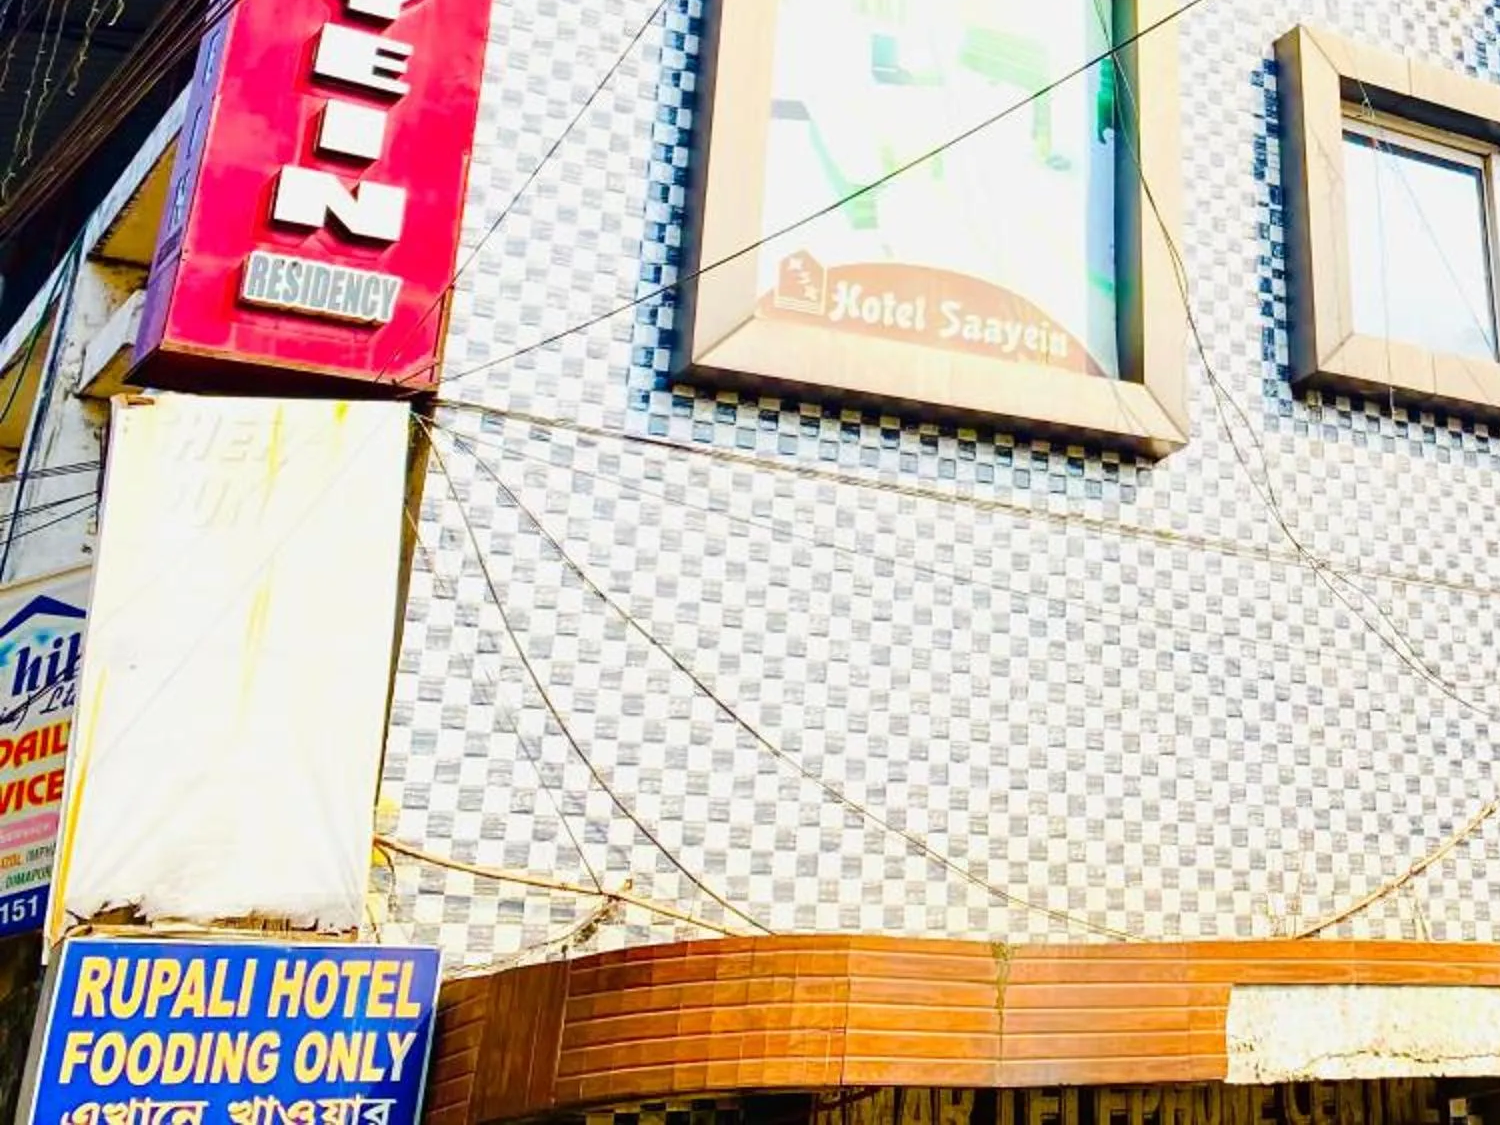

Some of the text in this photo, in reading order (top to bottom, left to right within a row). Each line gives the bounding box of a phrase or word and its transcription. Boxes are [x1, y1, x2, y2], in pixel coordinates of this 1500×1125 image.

[244, 252, 402, 323] RESIDENCY
[827, 279, 1069, 358] Hotel Saayein
[71, 956, 421, 1020] RUPALI HOTEL
[58, 1030, 417, 1086] FOODING ONLY
